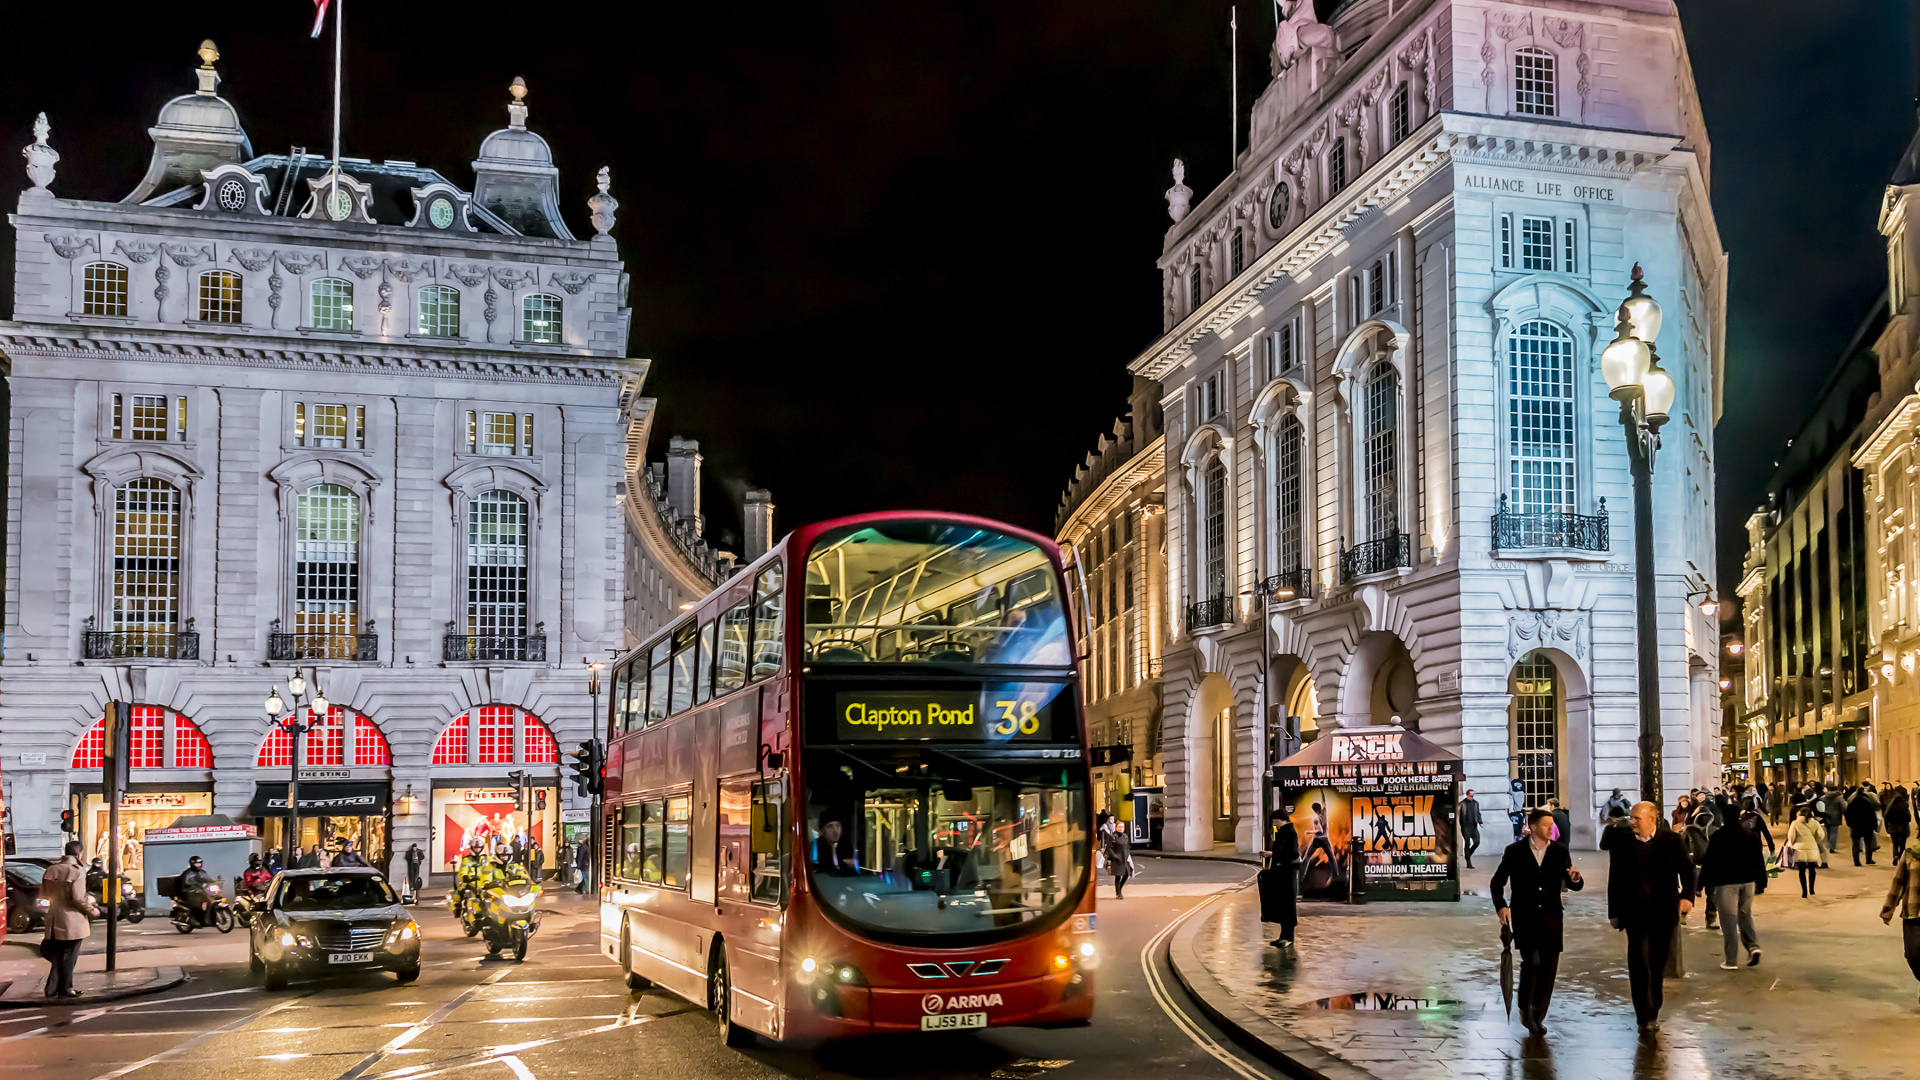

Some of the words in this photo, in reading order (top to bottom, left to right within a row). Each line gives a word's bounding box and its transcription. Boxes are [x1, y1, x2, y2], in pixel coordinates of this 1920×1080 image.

[1464, 174, 1524, 193] ALLIANCE
[1536, 182, 1562, 196] LIFE
[1573, 185, 1614, 201] OFFICE
[1489, 560, 1529, 570] COUNTY
[1571, 561, 1591, 571] FIRE
[1599, 563, 1630, 572] OFFICE
[844, 702, 922, 731] Clapton
[927, 702, 974, 725] Pond
[995, 700, 1040, 735] 38
[1331, 734, 1403, 761] ROCK
[1367, 752, 1404, 760] YOU
[1299, 766, 1314, 778] WE
[1316, 765, 1339, 778] WILL
[1342, 764, 1357, 777] WE
[1360, 763, 1384, 776] WILL
[1386, 762, 1414, 775] ROCK
[1417, 762, 1437, 774] YOU
[1284, 779, 1305, 787] HALF
[1305, 778, 1328, 786] PRICE
[1383, 776, 1408, 784] BOOK
[1409, 775, 1429, 783] HERE
[314, 797, 370, 806] STING
[1373, 797, 1387, 805] WE
[1391, 796, 1413, 805] WILL
[1353, 795, 1436, 851] ROCK
[1394, 836, 1436, 851] YOU
[1364, 864, 1407, 874] DOMINION
[1409, 864, 1447, 873] THEATRE
[333, 954, 351, 962] RJ10
[354, 953, 369, 961] EKK
[946, 993, 1003, 1009] ARRIVA
[926, 1016, 957, 1029] LJ59
[960, 1014, 982, 1026] AET
